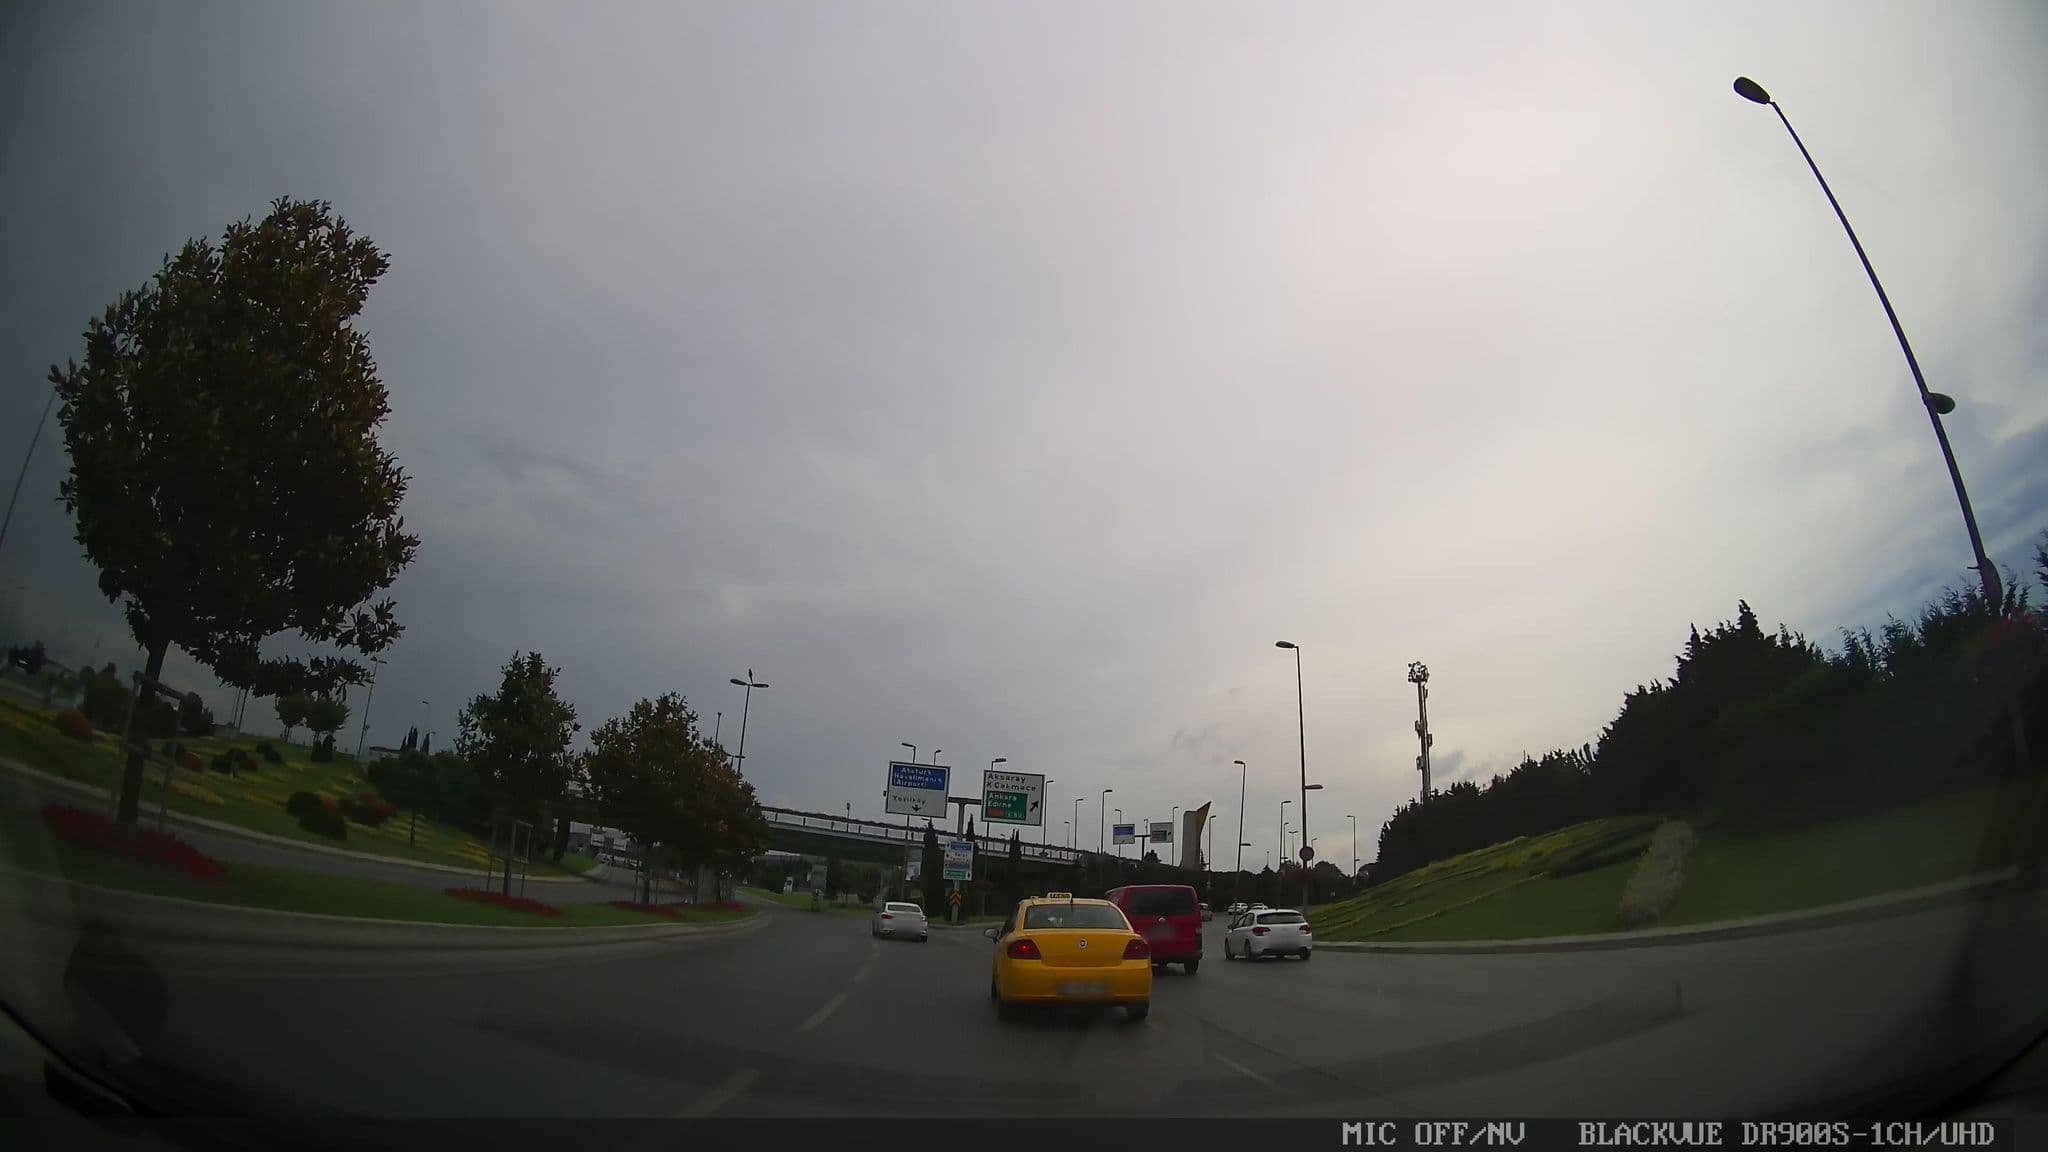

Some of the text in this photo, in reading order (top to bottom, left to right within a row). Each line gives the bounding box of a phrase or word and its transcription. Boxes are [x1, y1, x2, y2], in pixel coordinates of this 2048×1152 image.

[987, 773, 1026, 783] Aksaray
[988, 792, 1017, 801] Ankara
[988, 800, 1012, 808] Edirne
